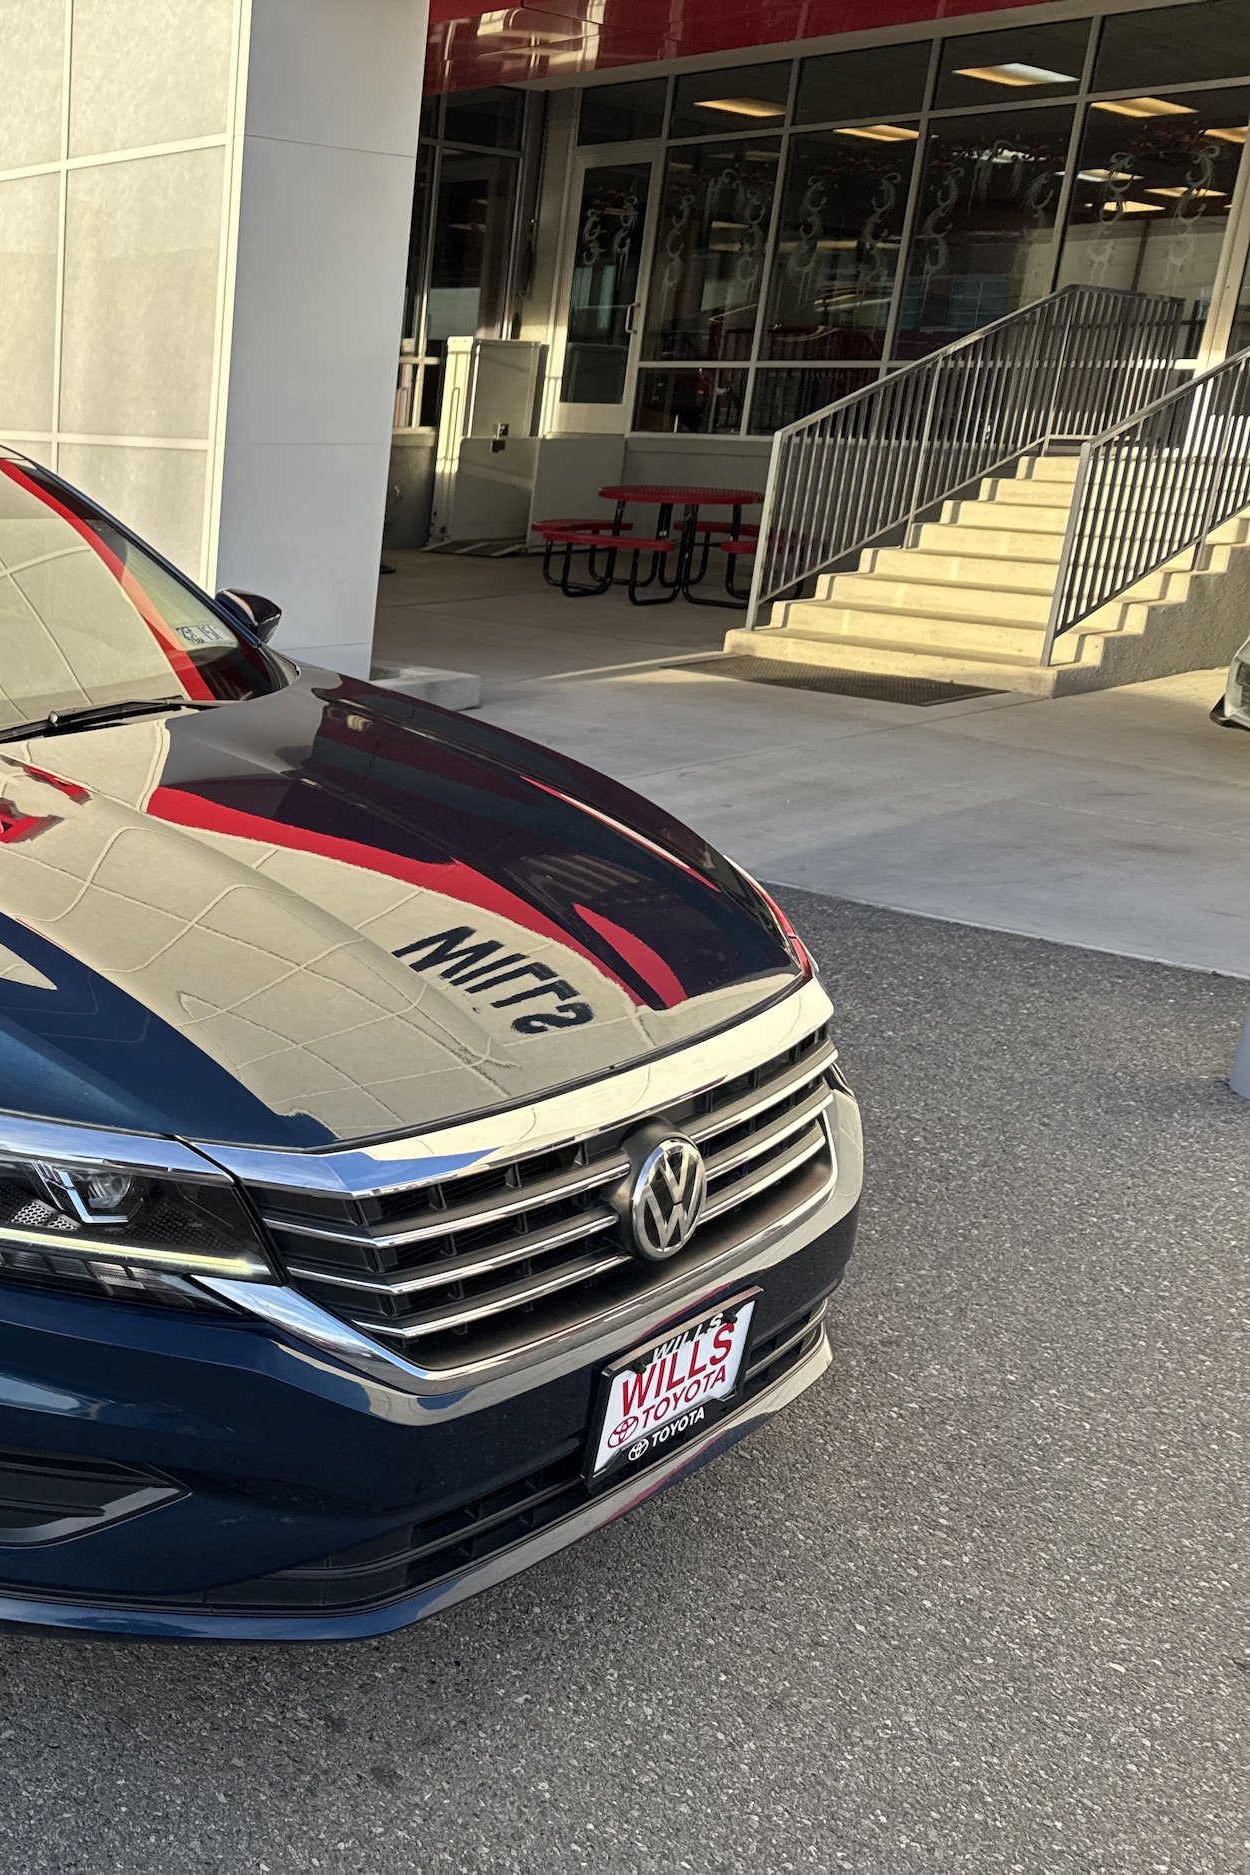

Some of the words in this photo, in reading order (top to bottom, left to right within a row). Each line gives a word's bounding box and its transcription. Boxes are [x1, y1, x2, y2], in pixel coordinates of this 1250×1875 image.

[622, 1323, 735, 1417] WILLS
[642, 1364, 726, 1429] TOYOTA
[651, 1406, 705, 1447] TOYOTA
